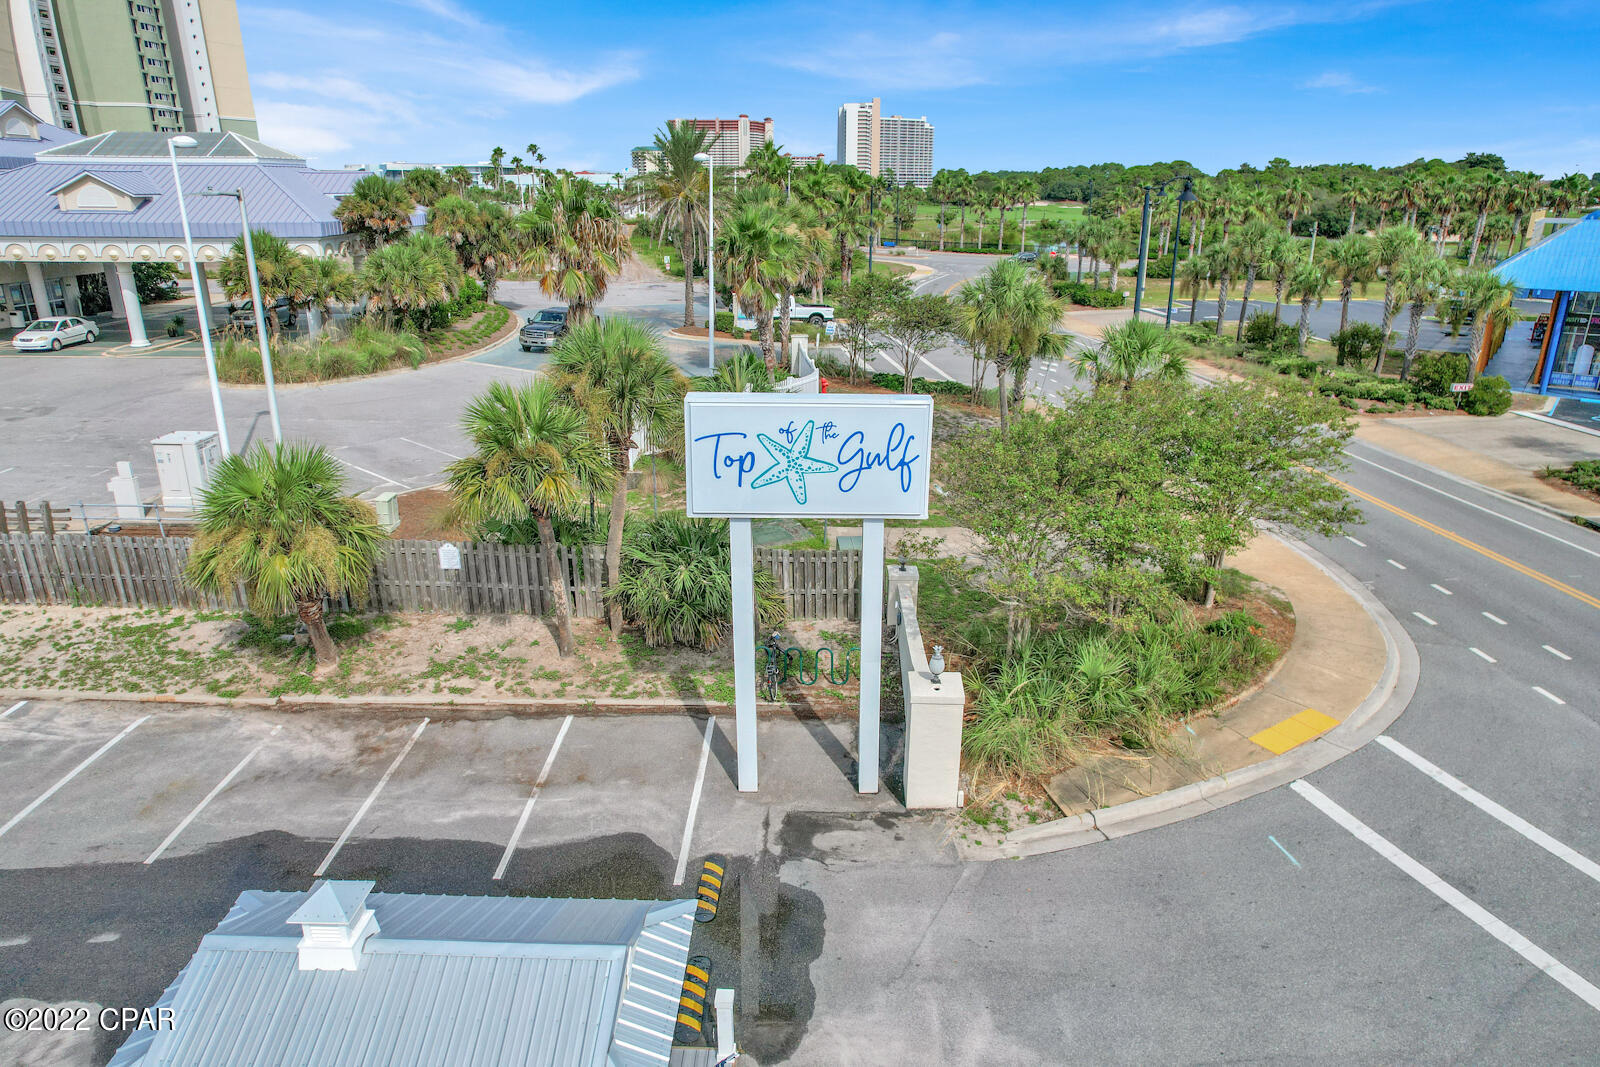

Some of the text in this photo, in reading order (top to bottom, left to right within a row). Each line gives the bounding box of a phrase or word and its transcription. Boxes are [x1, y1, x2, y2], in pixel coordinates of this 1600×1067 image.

[694, 420, 920, 494] Top of the Gulf
